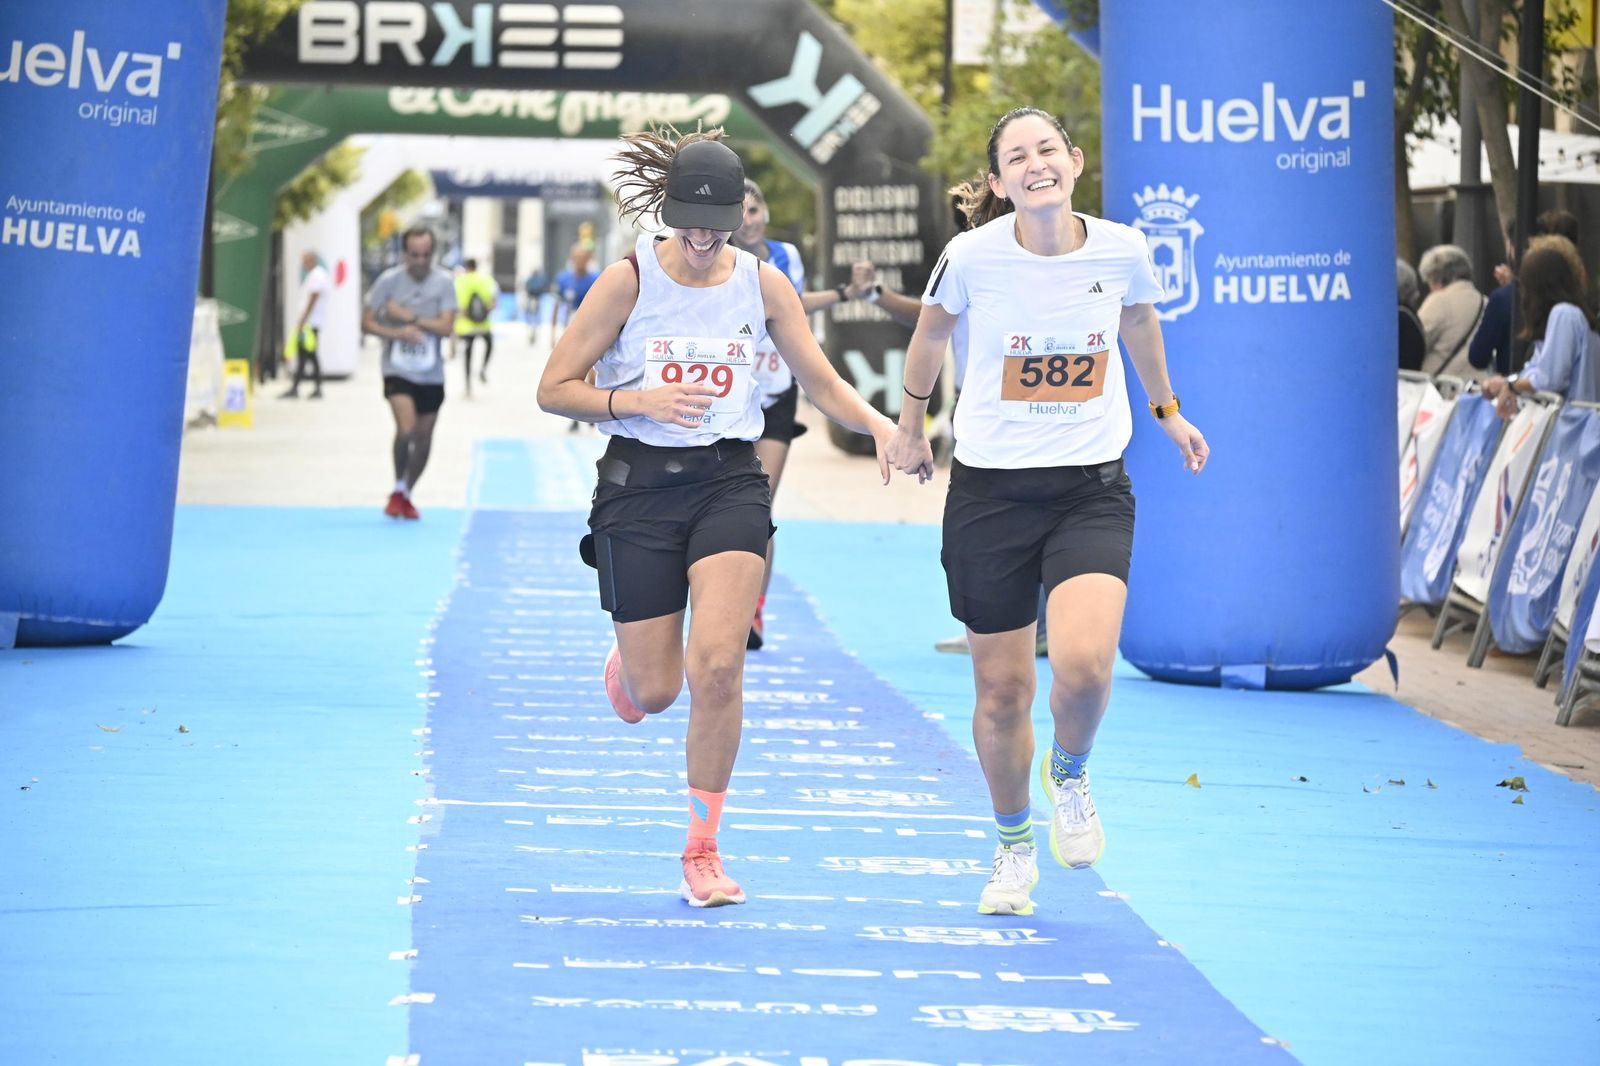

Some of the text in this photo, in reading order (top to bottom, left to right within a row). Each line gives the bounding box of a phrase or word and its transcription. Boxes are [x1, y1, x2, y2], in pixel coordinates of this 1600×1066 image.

[79, 101, 158, 127] original
[1132, 81, 1350, 143] Huelva
[1276, 147, 1351, 174] original
[6, 194, 146, 224] Ayuntamiento de
[1, 216, 142, 259] HUELVA
[1214, 249, 1351, 273] Ayuntamiento de
[1213, 272, 1352, 304] HUELVA
[661, 362, 733, 398] 929
[1020, 355, 1095, 388] 582
[1029, 403, 1077, 415] Huelva
